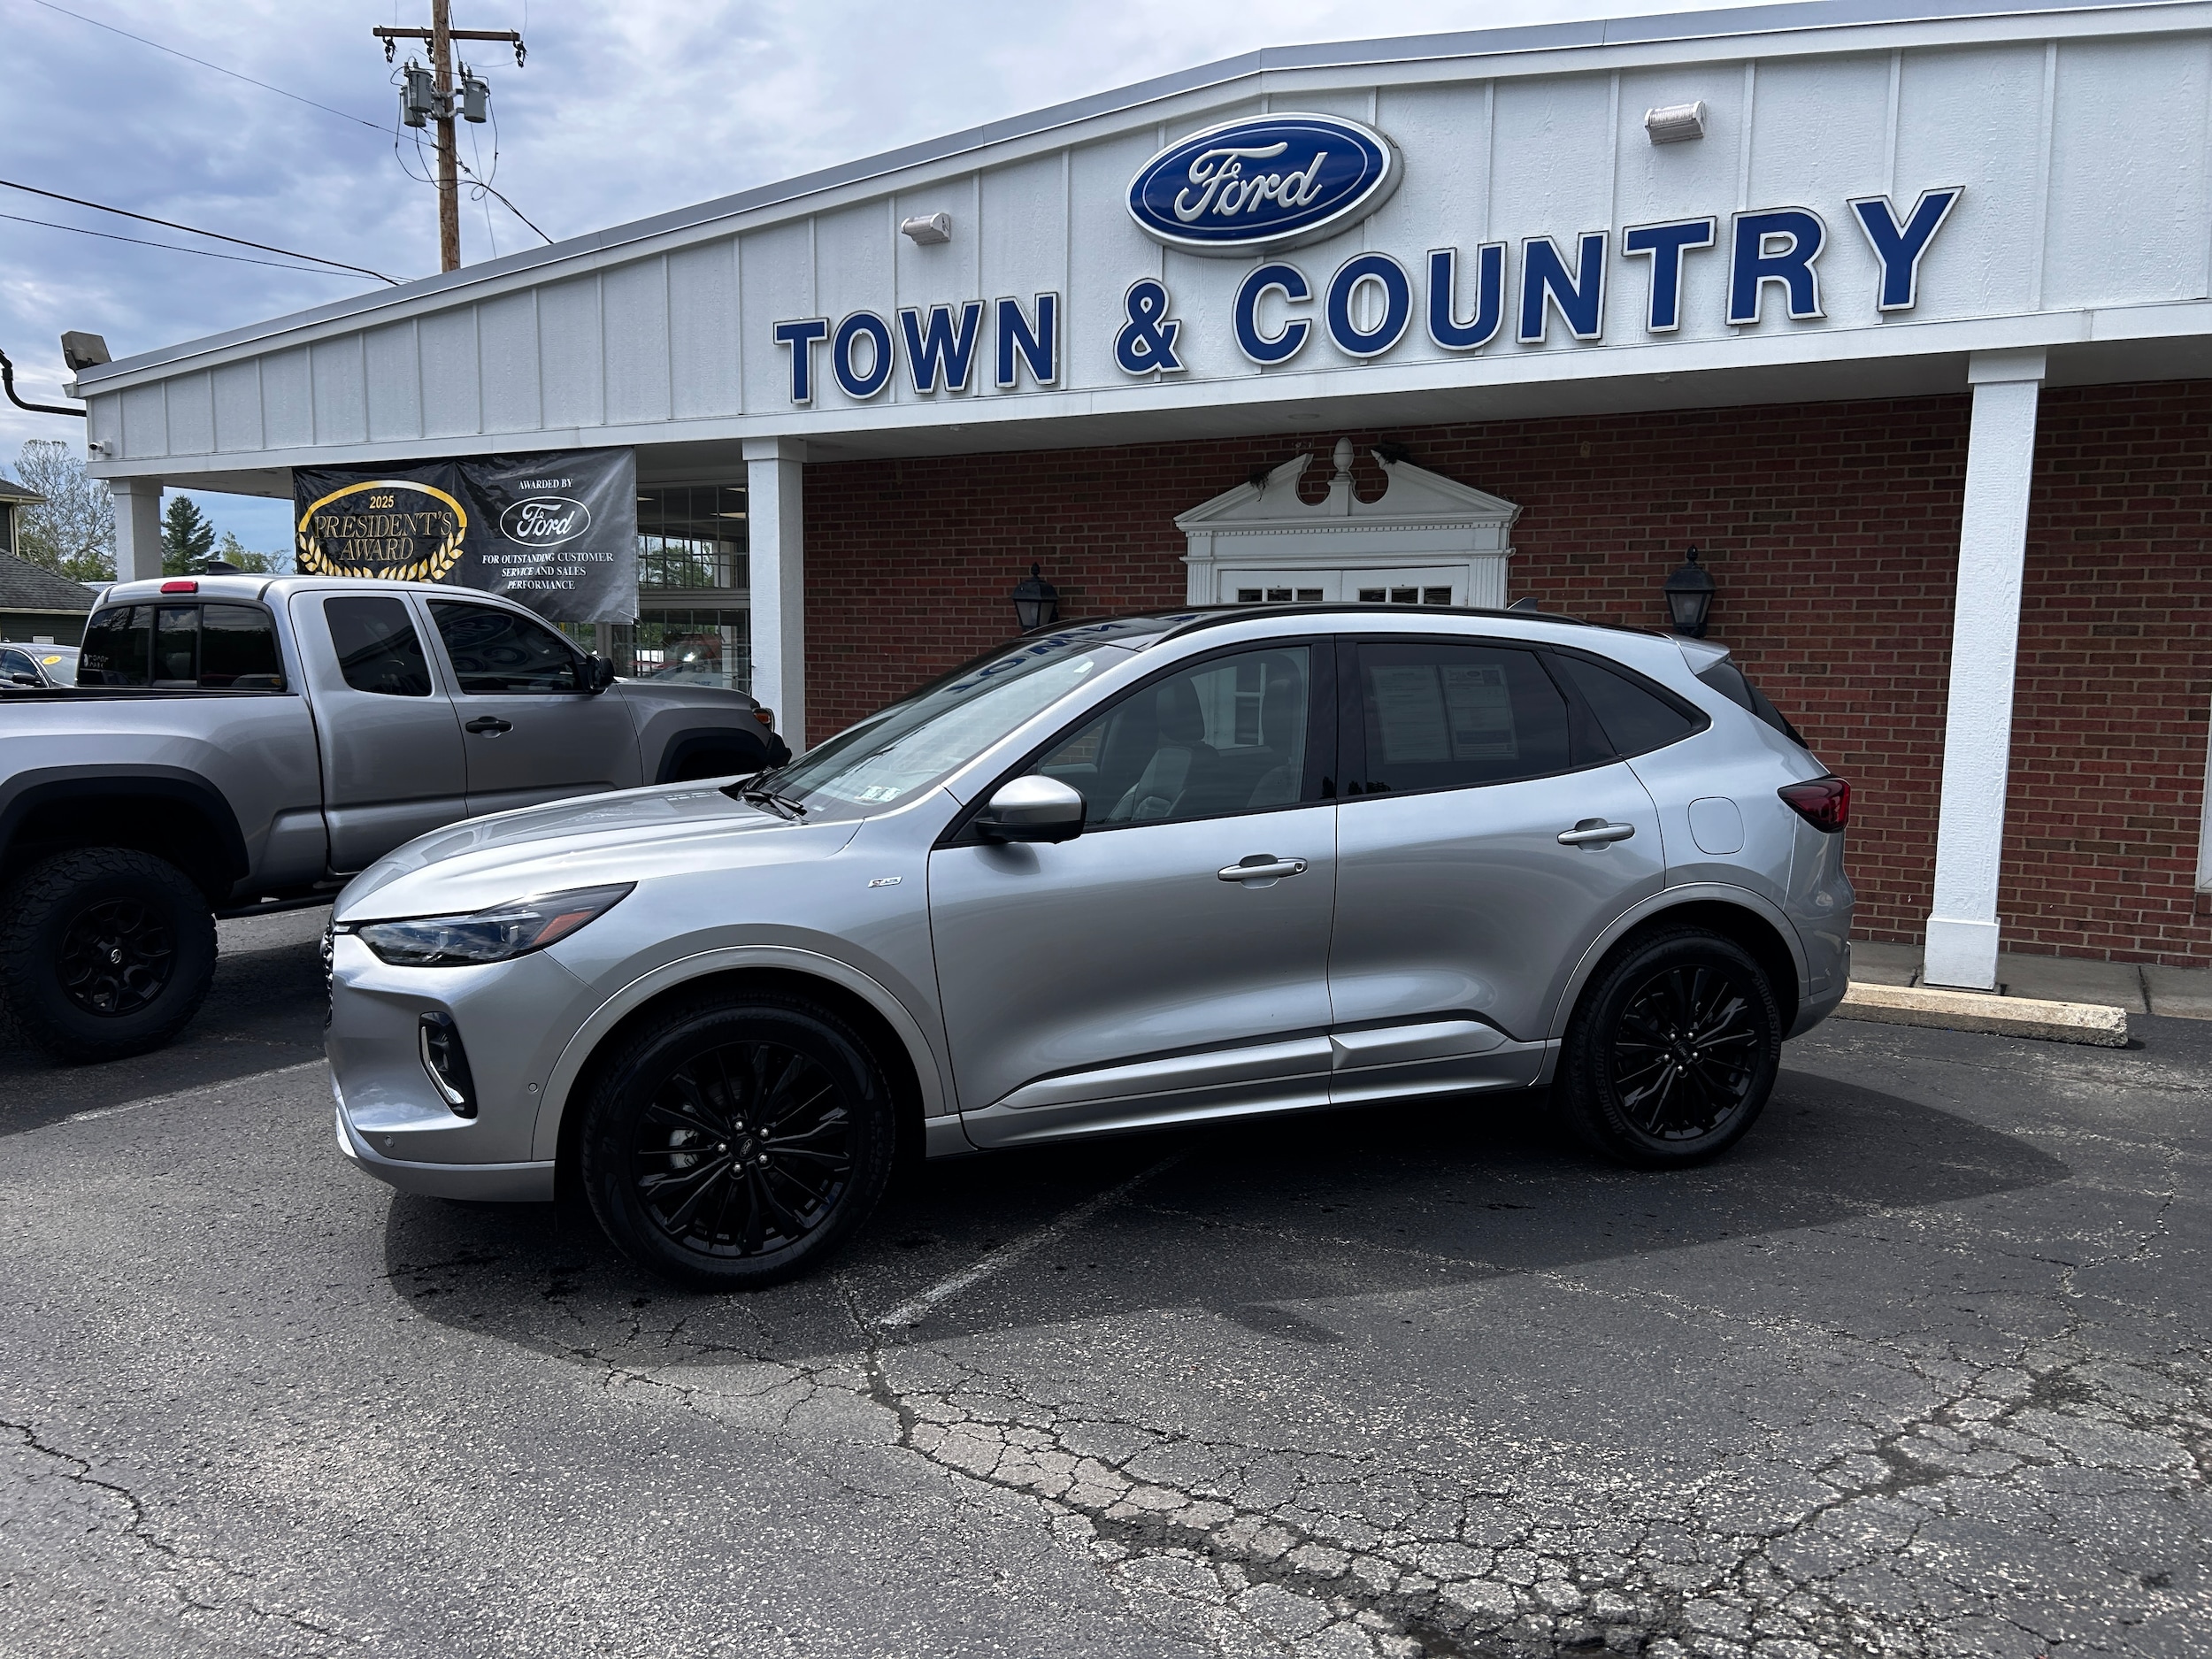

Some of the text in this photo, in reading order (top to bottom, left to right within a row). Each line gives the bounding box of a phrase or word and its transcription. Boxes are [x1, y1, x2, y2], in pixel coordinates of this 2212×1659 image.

[1173, 142, 1329, 223] Ford
[772, 185, 1967, 404] TOWN & COUNTRY
[518, 478, 574, 490] AWARDED BY
[369, 495, 395, 509] 2025
[313, 511, 454, 539] PRESIDENT'S
[516, 503, 576, 538] Ford
[338, 537, 415, 562] AWARD
[482, 552, 615, 565] FOR OUTSTANDING CUSTOMER
[501, 565, 587, 577] SERVICE AND SALES
[507, 580, 576, 590] PERFORMANCE
